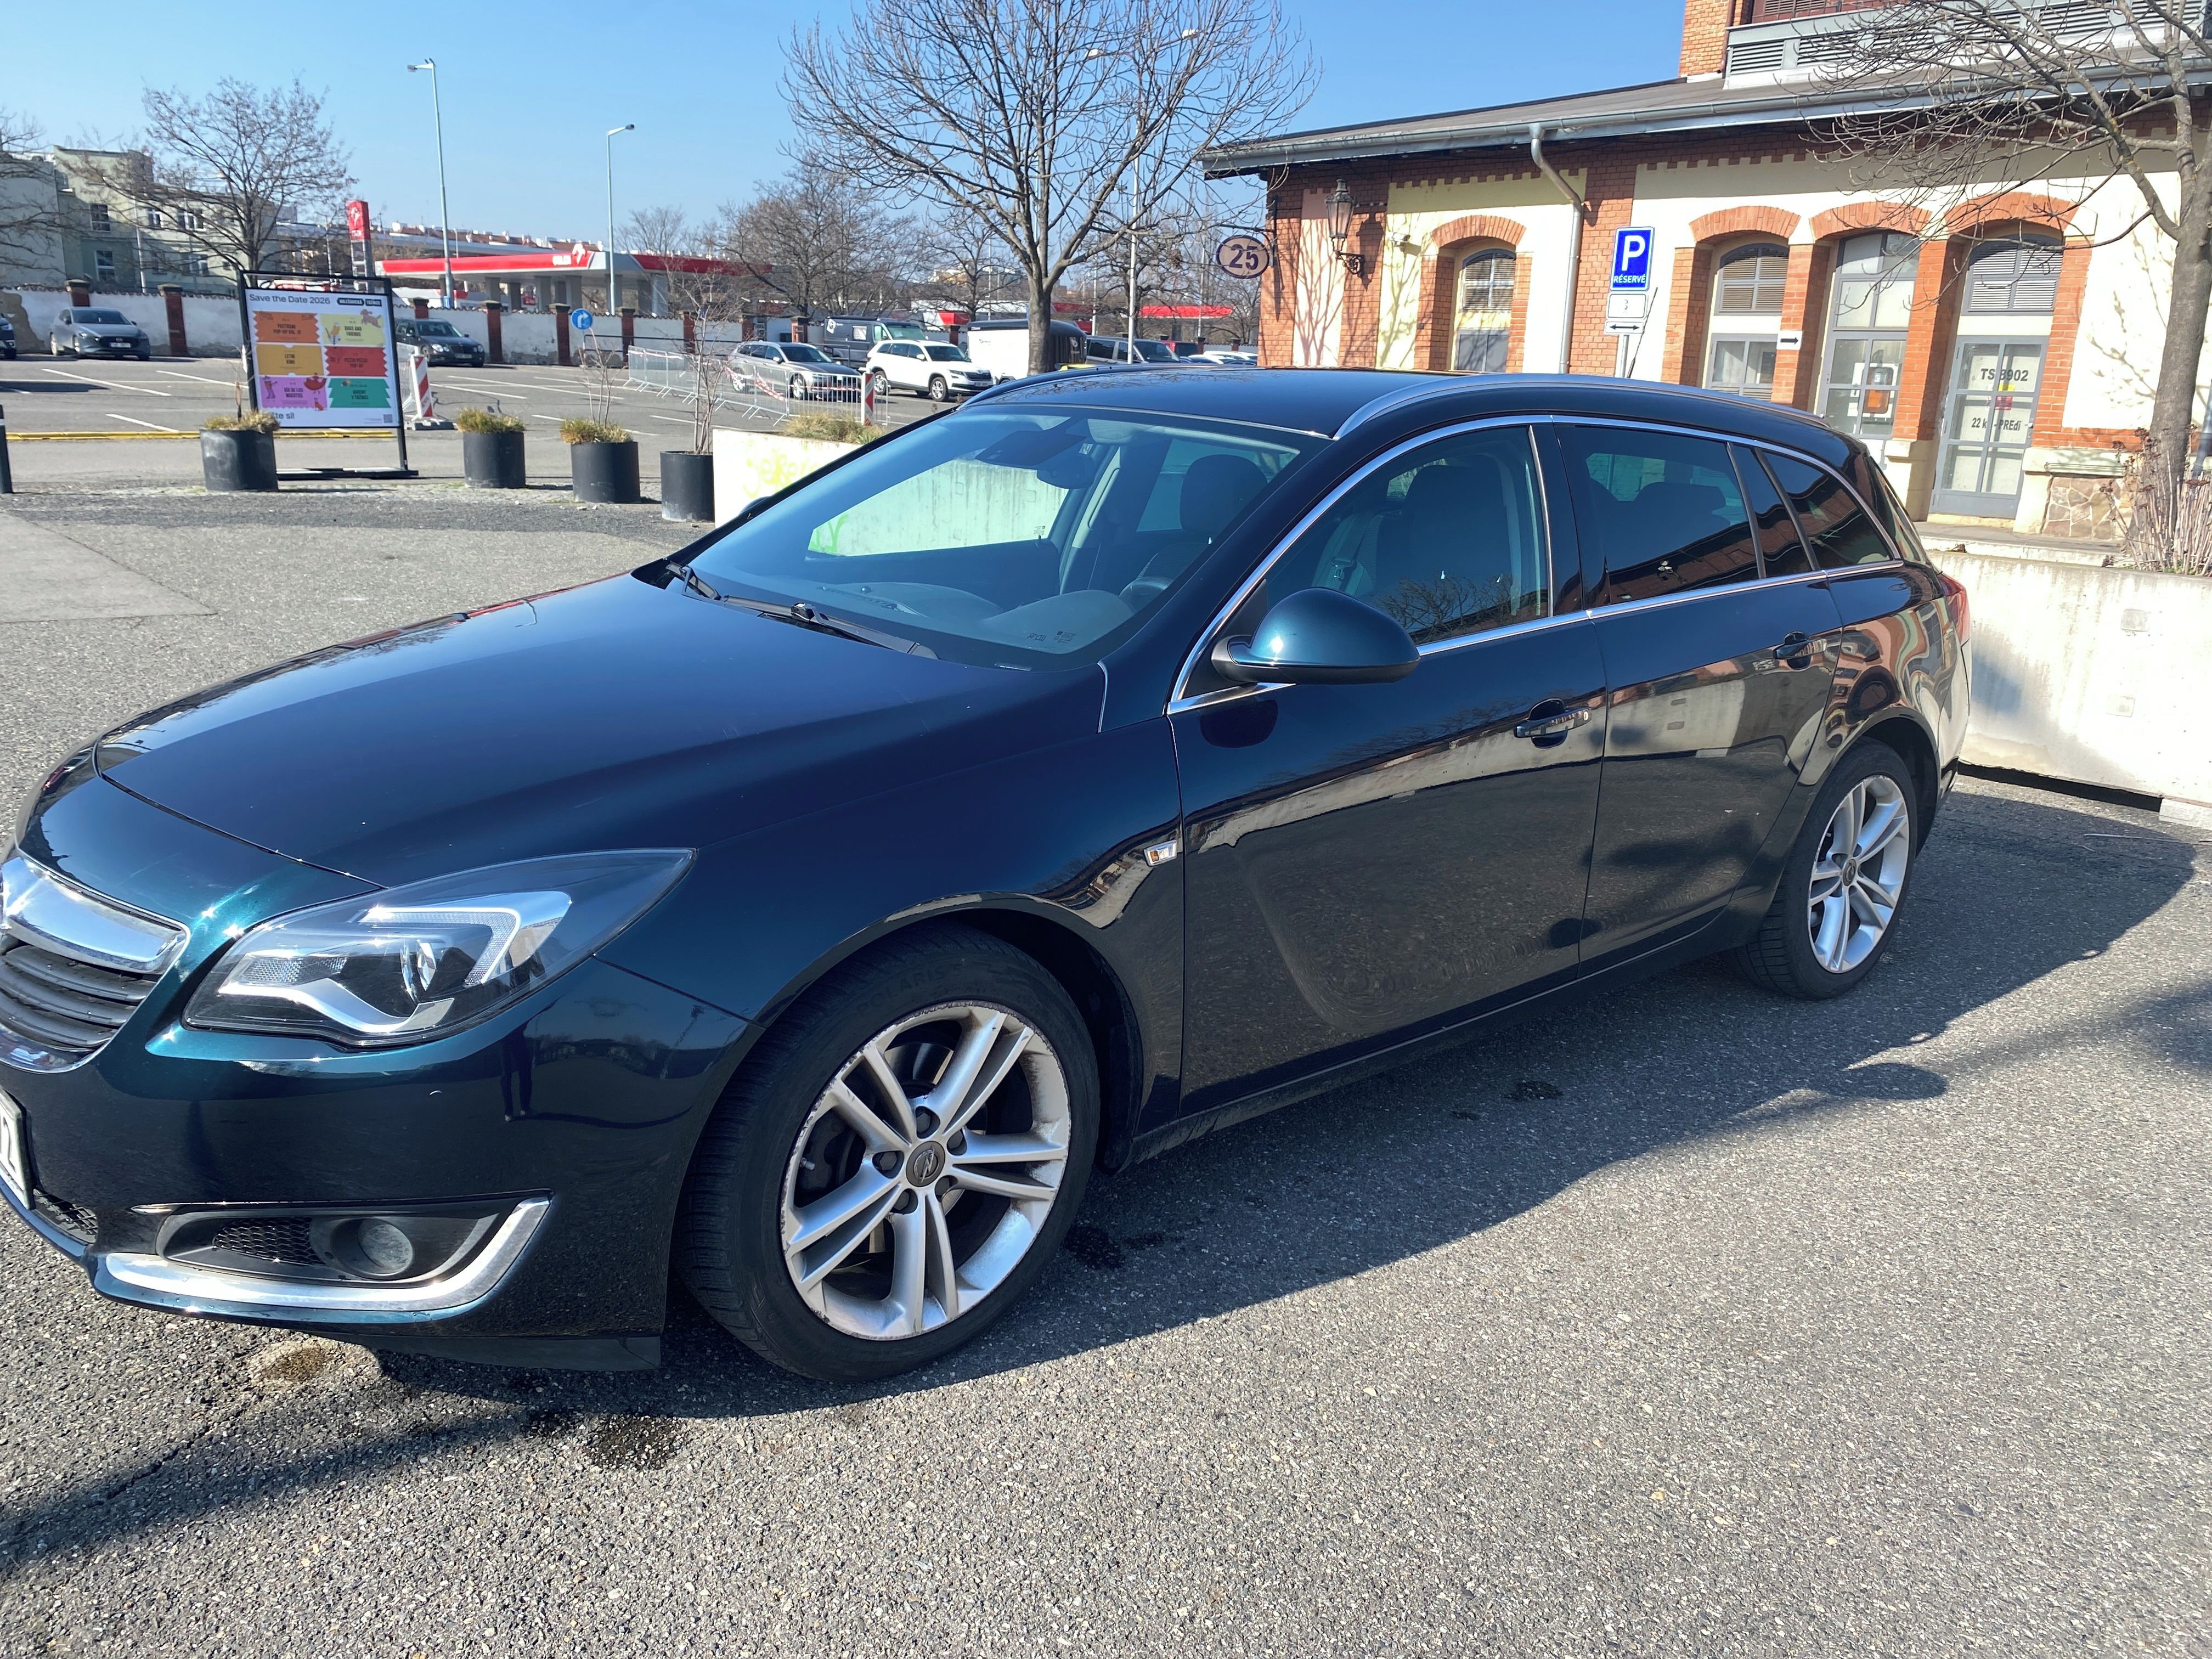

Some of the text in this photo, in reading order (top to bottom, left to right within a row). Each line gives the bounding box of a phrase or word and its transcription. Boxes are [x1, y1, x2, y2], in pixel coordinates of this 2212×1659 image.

[1229, 244, 1259, 270] 25
[1622, 235, 1645, 271] P
[1613, 274, 1646, 284] RÉSERVÉ
[1980, 368, 2029, 381] TS 8902
[1971, 417, 1980, 428] 22
